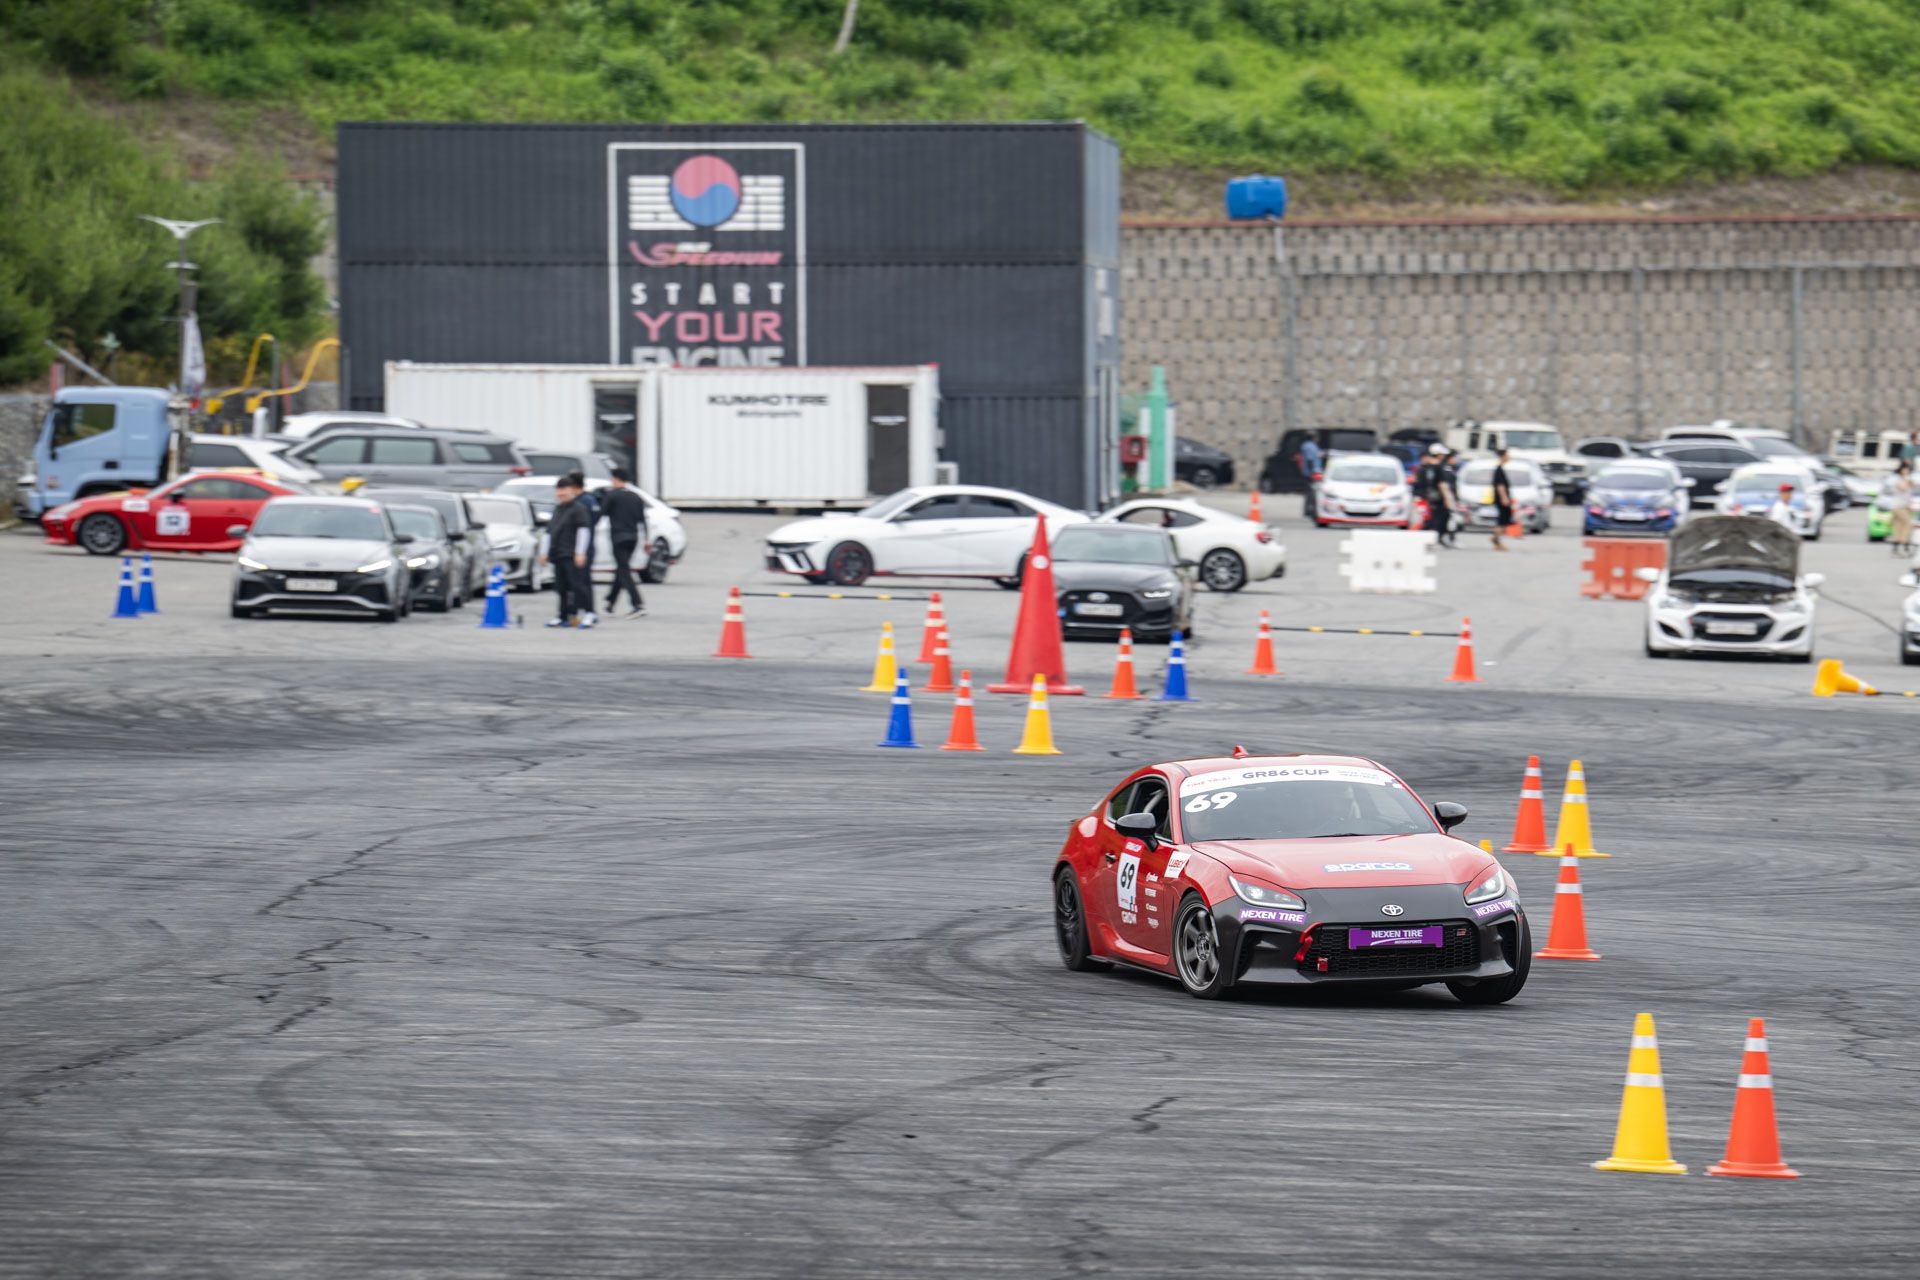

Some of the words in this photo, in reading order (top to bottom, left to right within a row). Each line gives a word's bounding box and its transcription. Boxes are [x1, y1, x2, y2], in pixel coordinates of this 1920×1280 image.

[631, 282, 784, 305] START
[634, 311, 783, 342] YOUR
[708, 395, 782, 406] KUMHO
[784, 395, 829, 406] TIRE
[1242, 769, 1289, 779] GR86
[1184, 791, 1238, 813] 69
[1325, 862, 1412, 872] sparco
[1120, 862, 1135, 890] 69
[1240, 909, 1277, 920] NEXEN
[1278, 912, 1305, 923] TIRE
[1474, 903, 1501, 917] NEXEN
[1498, 899, 1514, 910] TIRE
[1371, 930, 1401, 938] NEXEN
[1402, 929, 1423, 937] TIRE
